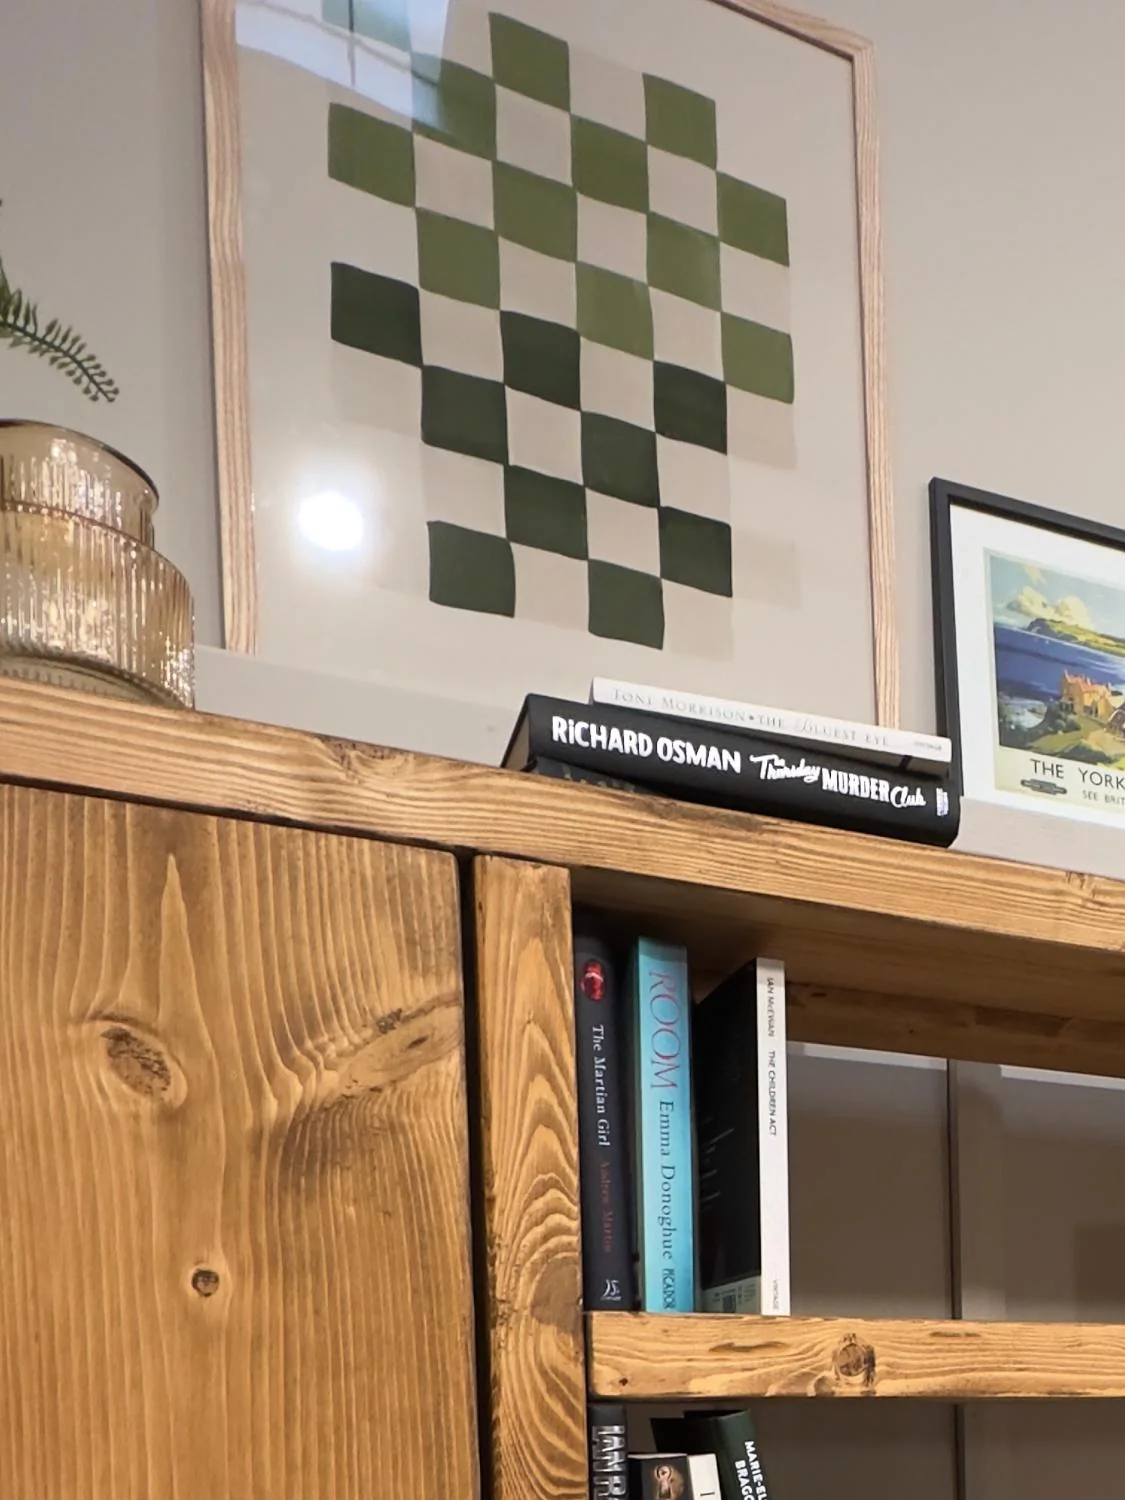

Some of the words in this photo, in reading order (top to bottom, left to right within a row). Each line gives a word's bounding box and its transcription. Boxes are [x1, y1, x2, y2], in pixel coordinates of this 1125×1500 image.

[660, 694, 747, 722] MORRISON
[656, 736, 742, 773] OSMAN
[1029, 758, 1065, 779] THE
[821, 767, 890, 803] MURDER
[890, 785, 926, 808] Club
[1081, 789, 1098, 802] SEE
[767, 977, 775, 995] IAN
[592, 1024, 605, 1052] The
[648, 970, 682, 1089] ROOM
[768, 1051, 776, 1068] THE
[594, 1056, 608, 1114] Martian
[768, 1070, 777, 1117] CHILDREN
[597, 1118, 611, 1147] Girl
[659, 1100, 674, 1157] Emma
[769, 1118, 777, 1137] ACT
[657, 1165, 677, 1260] Donoghue
[592, 1425, 626, 1473] IAN
